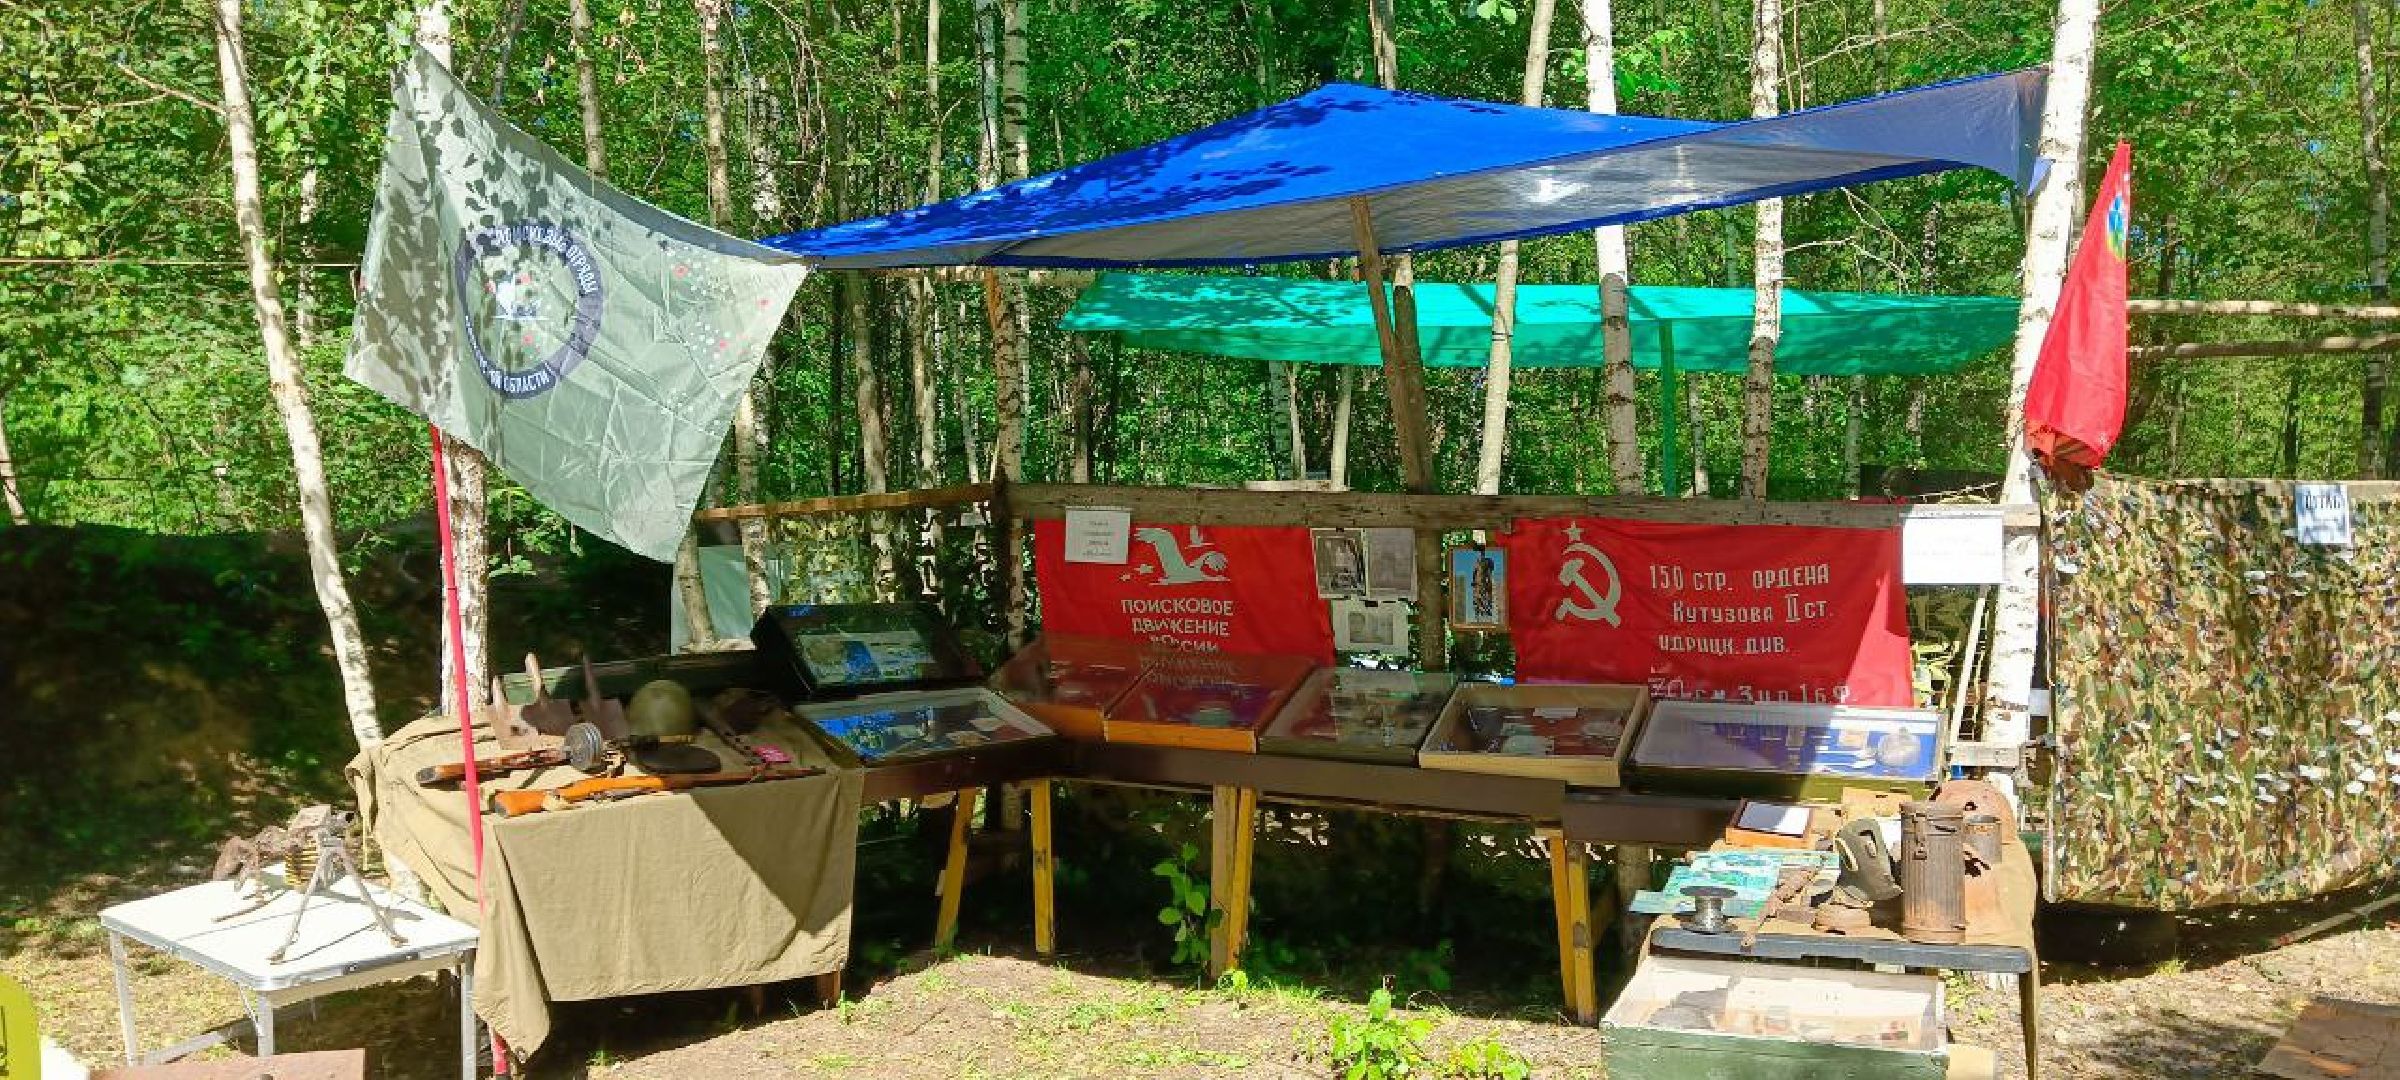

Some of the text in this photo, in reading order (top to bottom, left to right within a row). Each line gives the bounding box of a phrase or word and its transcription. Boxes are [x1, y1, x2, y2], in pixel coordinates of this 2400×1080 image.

[1650, 563, 1830, 591] 150 СТР. ОРДЕНА
[1120, 597, 1234, 616] ПОИСКОВОЕ
[1131, 617, 1231, 637] ДВИЖЕНИЕ
